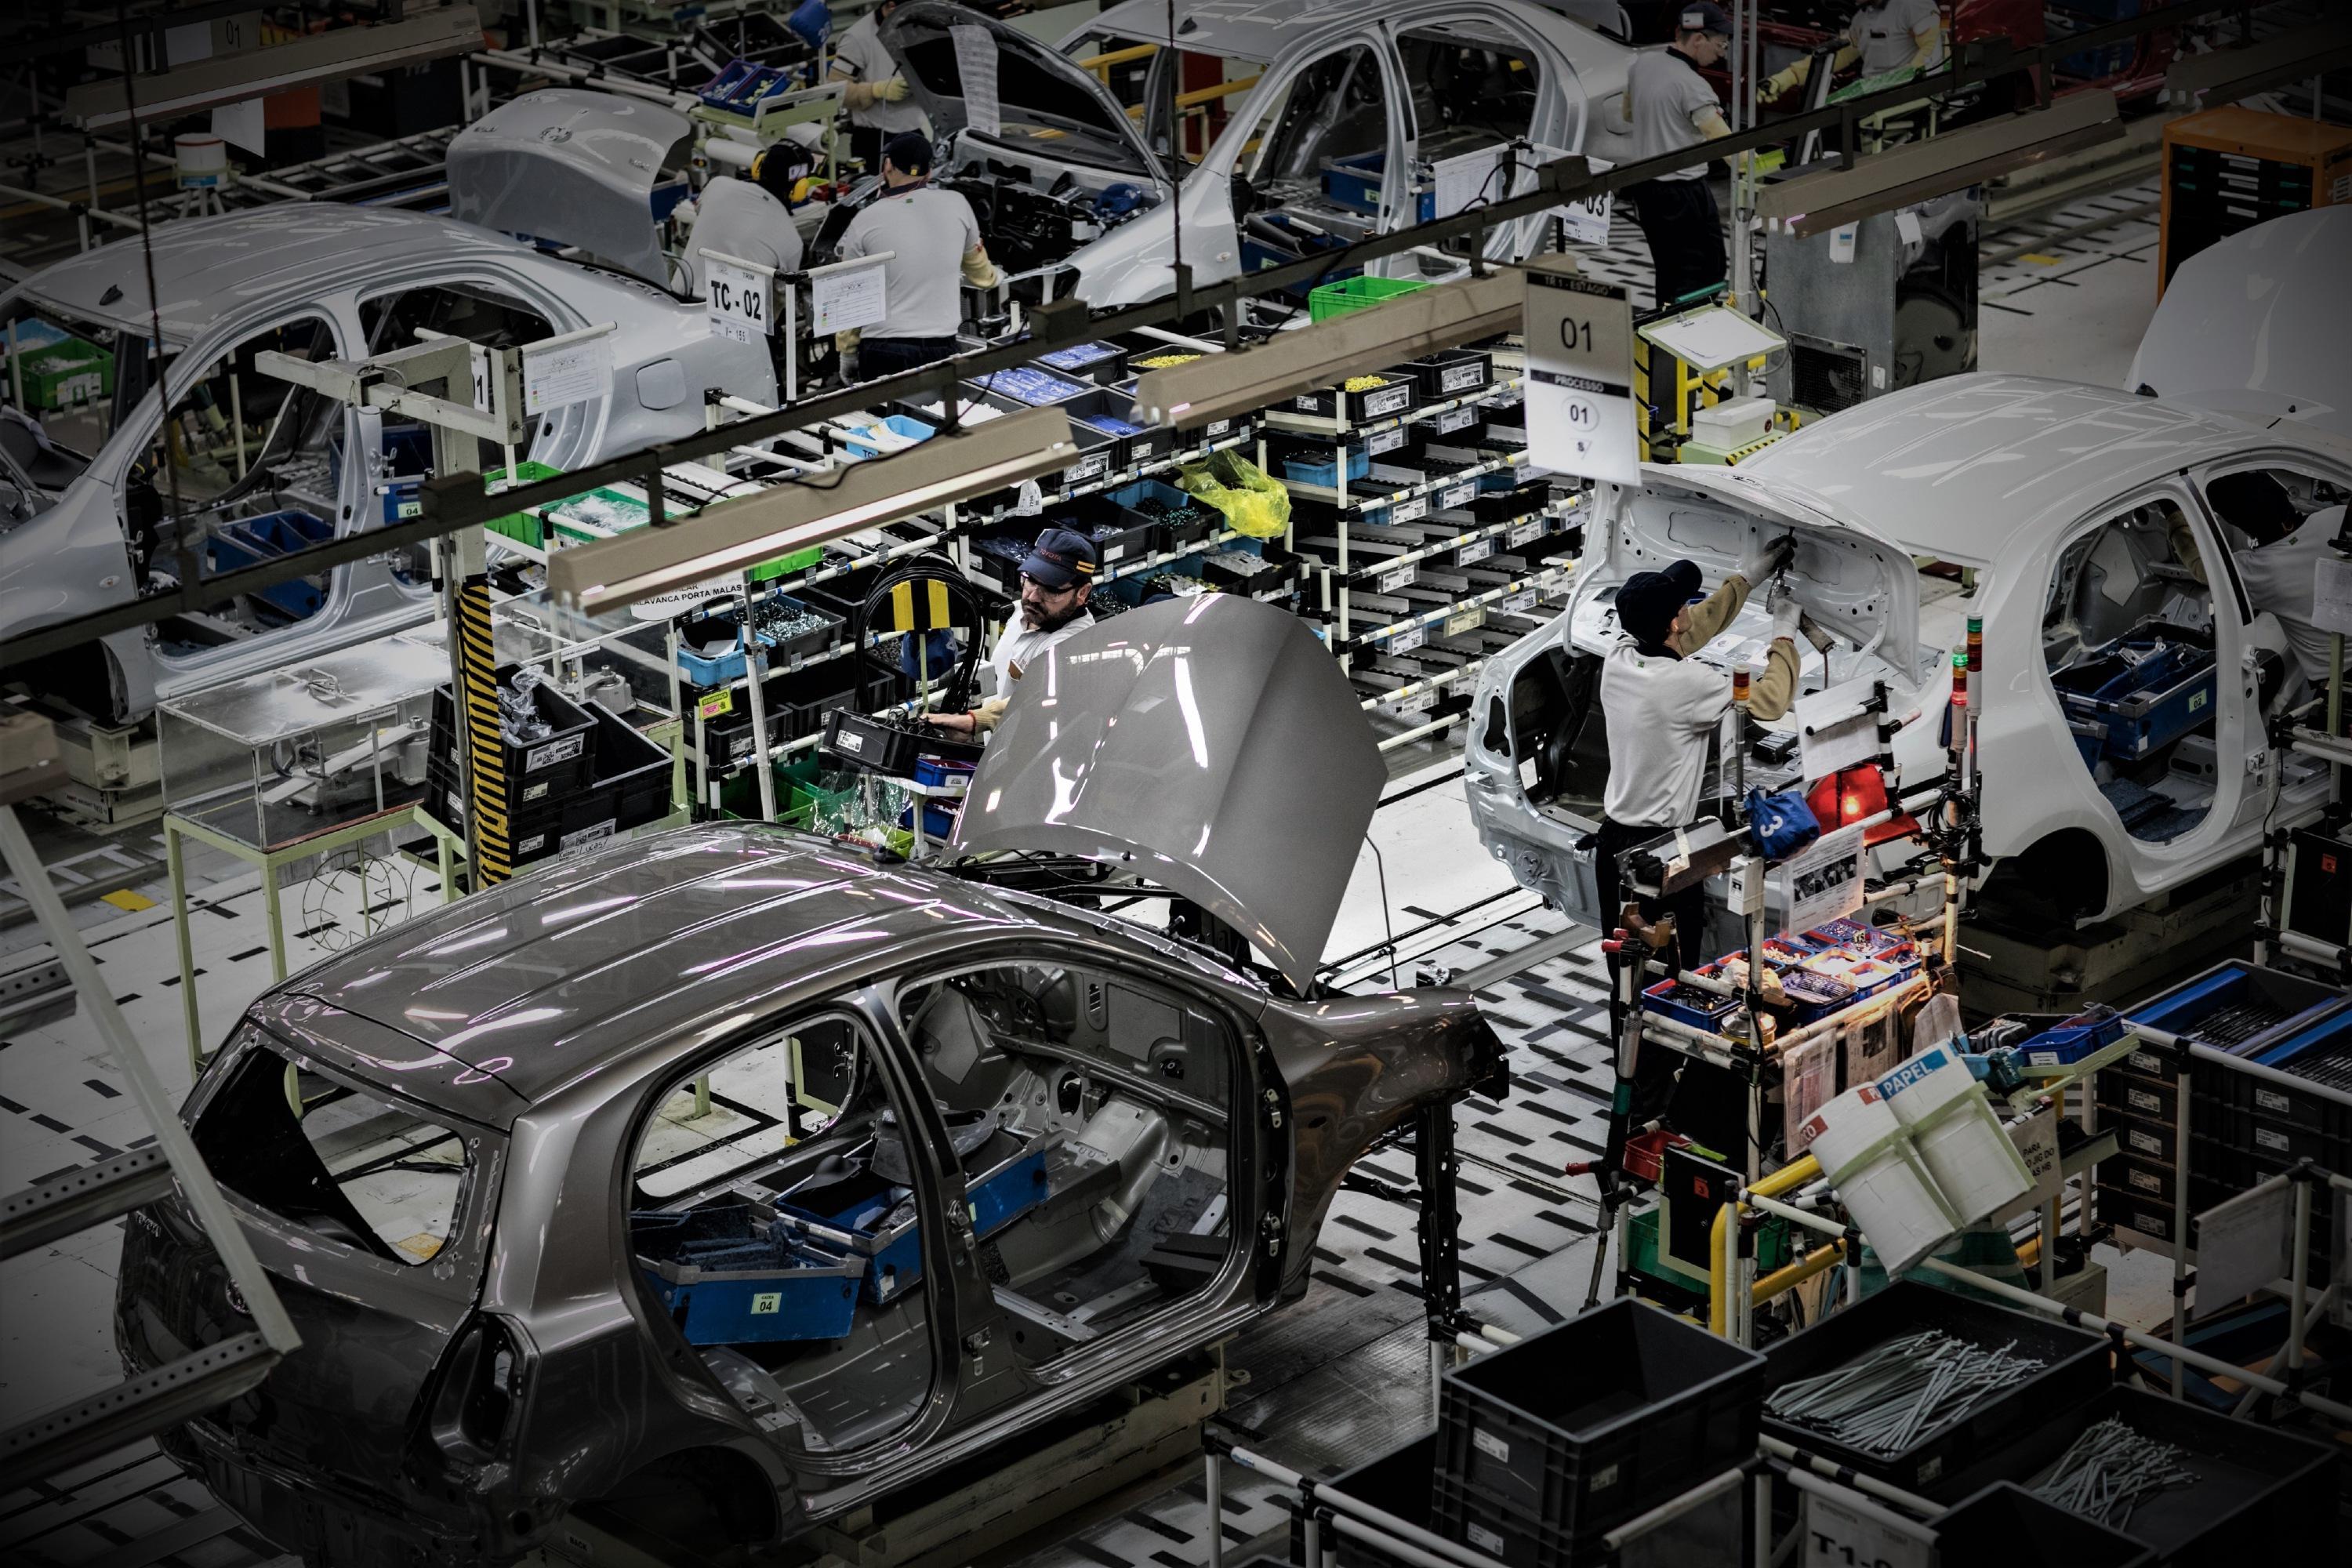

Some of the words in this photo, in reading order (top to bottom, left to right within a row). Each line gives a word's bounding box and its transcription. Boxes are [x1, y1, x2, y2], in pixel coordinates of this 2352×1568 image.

[711, 280, 731, 311] TC
[744, 289, 762, 321] 02
[1561, 317, 1592, 352] 01
[1555, 375, 1605, 393] PROCESSO
[1570, 405, 1588, 424] 01
[406, 507, 419, 516] 04
[1040, 548, 1062, 562] TOYOTA
[682, 590, 710, 601] PORTA
[713, 584, 742, 595] MALAS
[2194, 698, 2202, 708] 02
[1759, 815, 1784, 838] 3
[1883, 1060, 1934, 1096] PAPEL
[2023, 1142, 2041, 1157] PARA
[2044, 1147, 2055, 1160] DO
[760, 1301, 773, 1312] 04
